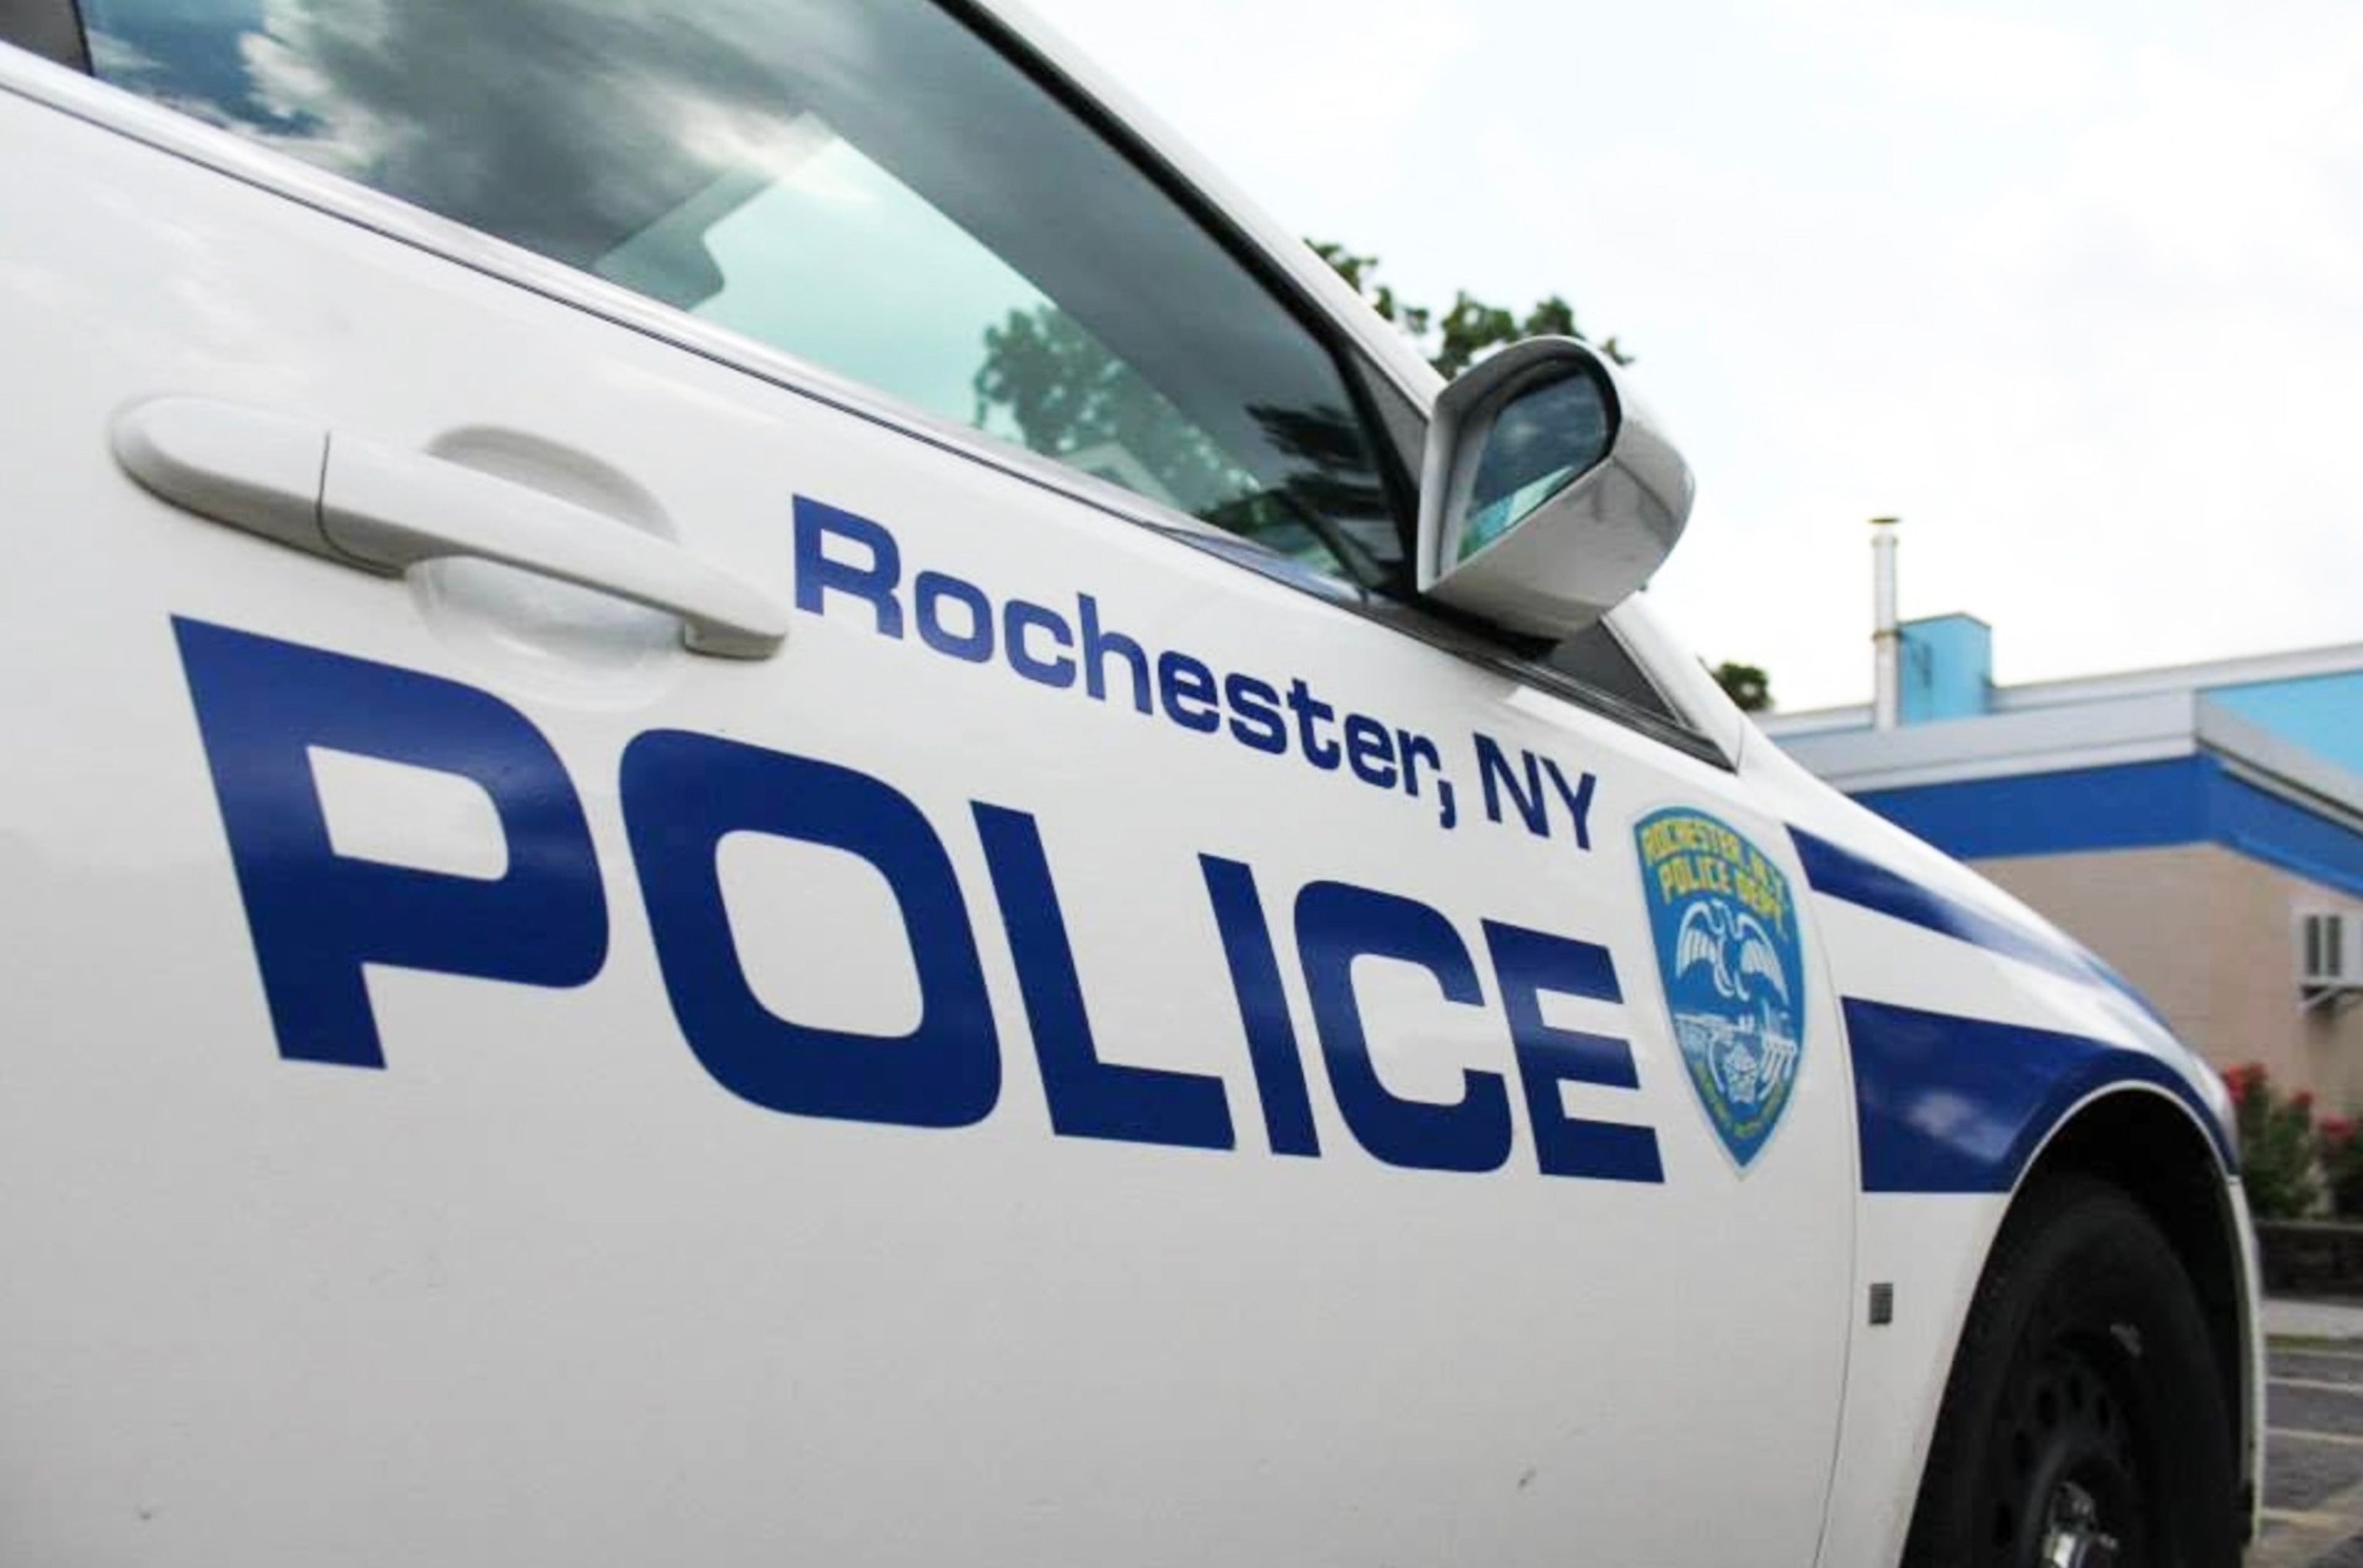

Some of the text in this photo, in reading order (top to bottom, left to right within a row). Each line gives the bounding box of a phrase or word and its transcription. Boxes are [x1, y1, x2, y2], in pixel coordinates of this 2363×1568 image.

[792, 494, 1597, 851] Rochester, NY
[172, 615, 1664, 1183] POLICE
[1658, 856, 1734, 906] POLICE
